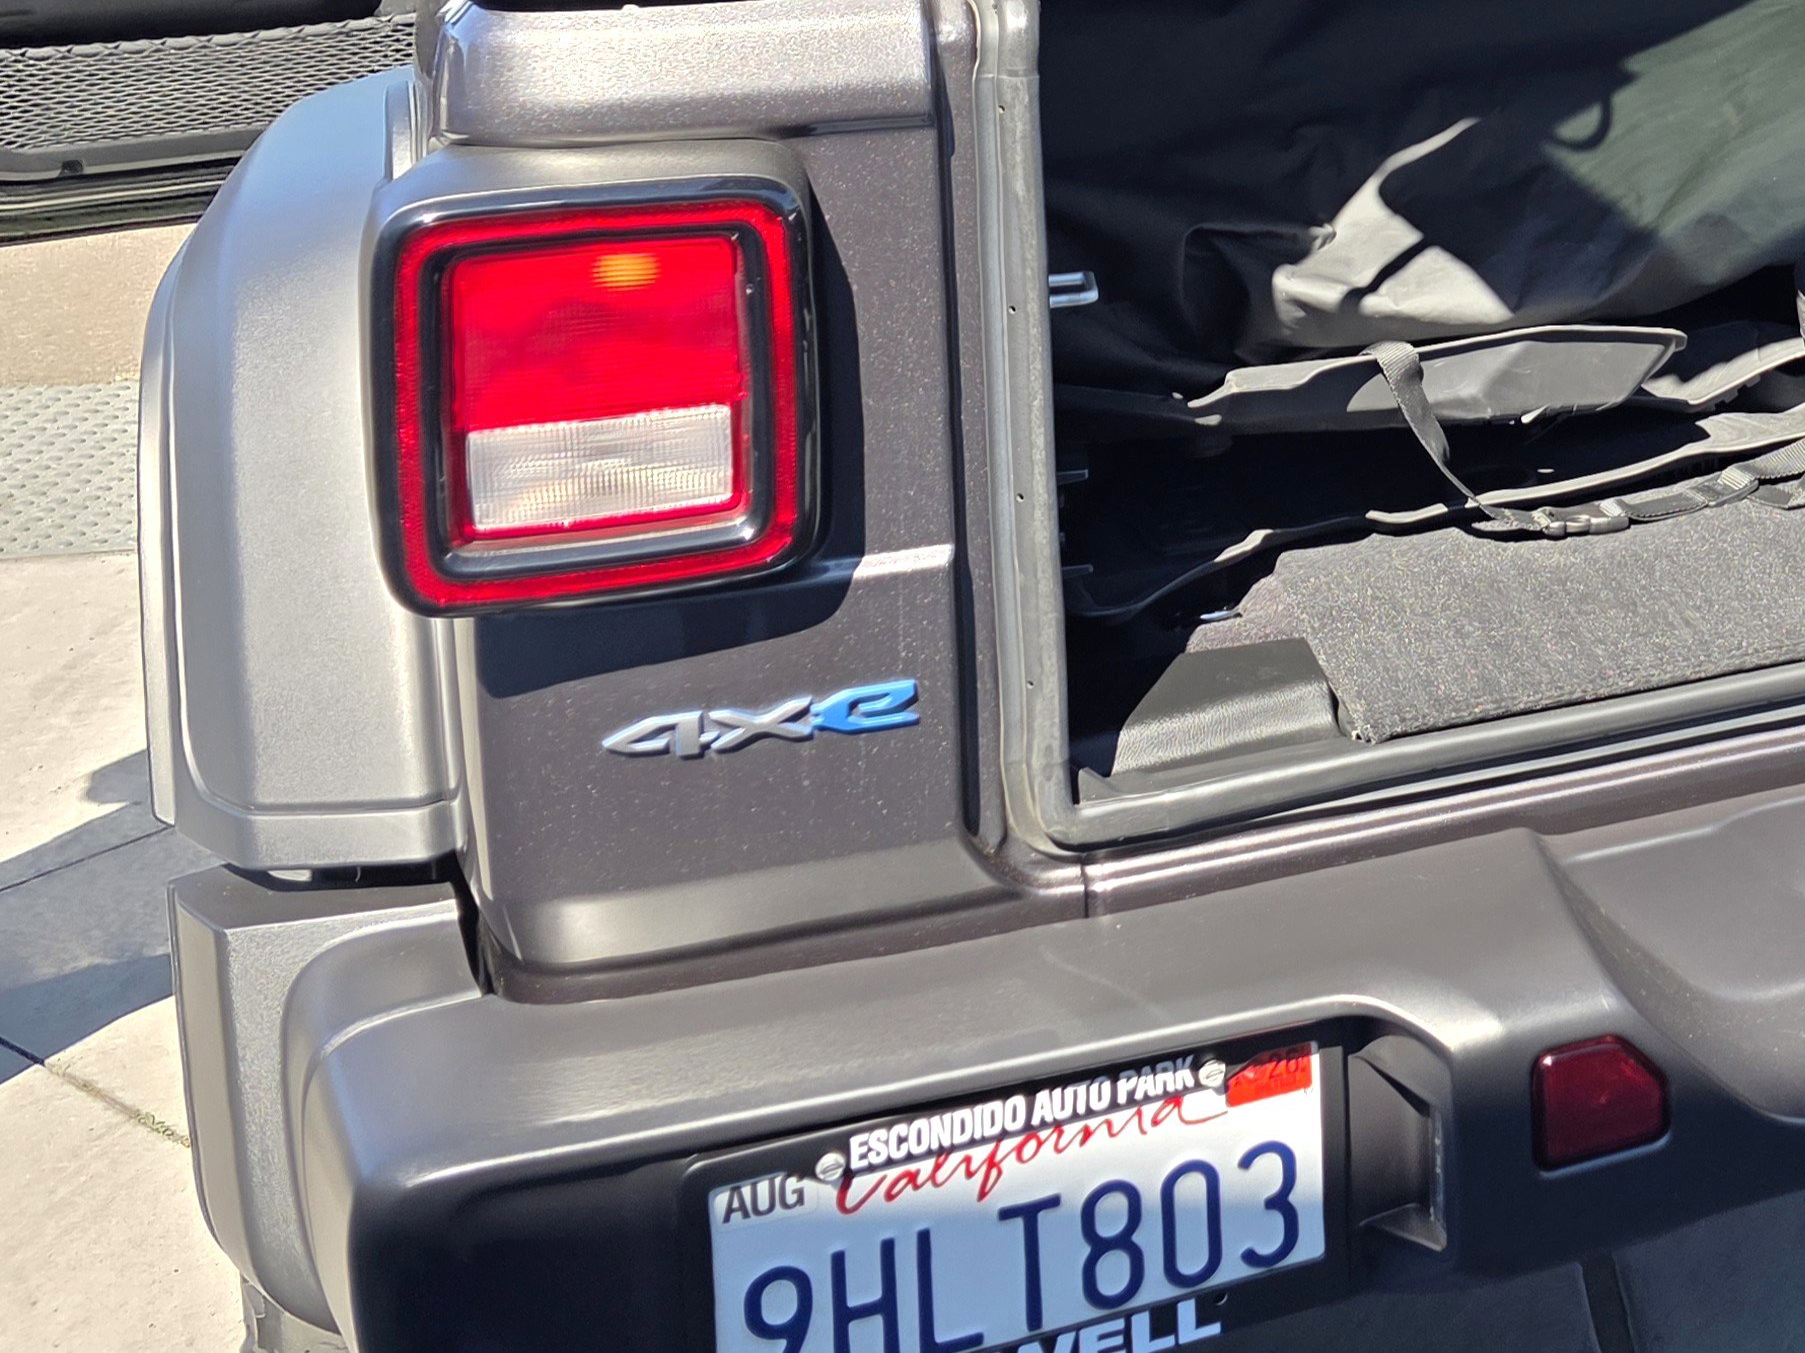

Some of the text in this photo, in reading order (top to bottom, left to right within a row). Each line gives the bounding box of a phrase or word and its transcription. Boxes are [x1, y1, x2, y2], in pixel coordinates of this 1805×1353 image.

[834, 1094, 1229, 1215] California
[849, 1055, 1196, 1170] ESCONDIDO AUTO PARK
[721, 1173, 806, 1224] AUG
[743, 1139, 1300, 1353] 9HLT803
